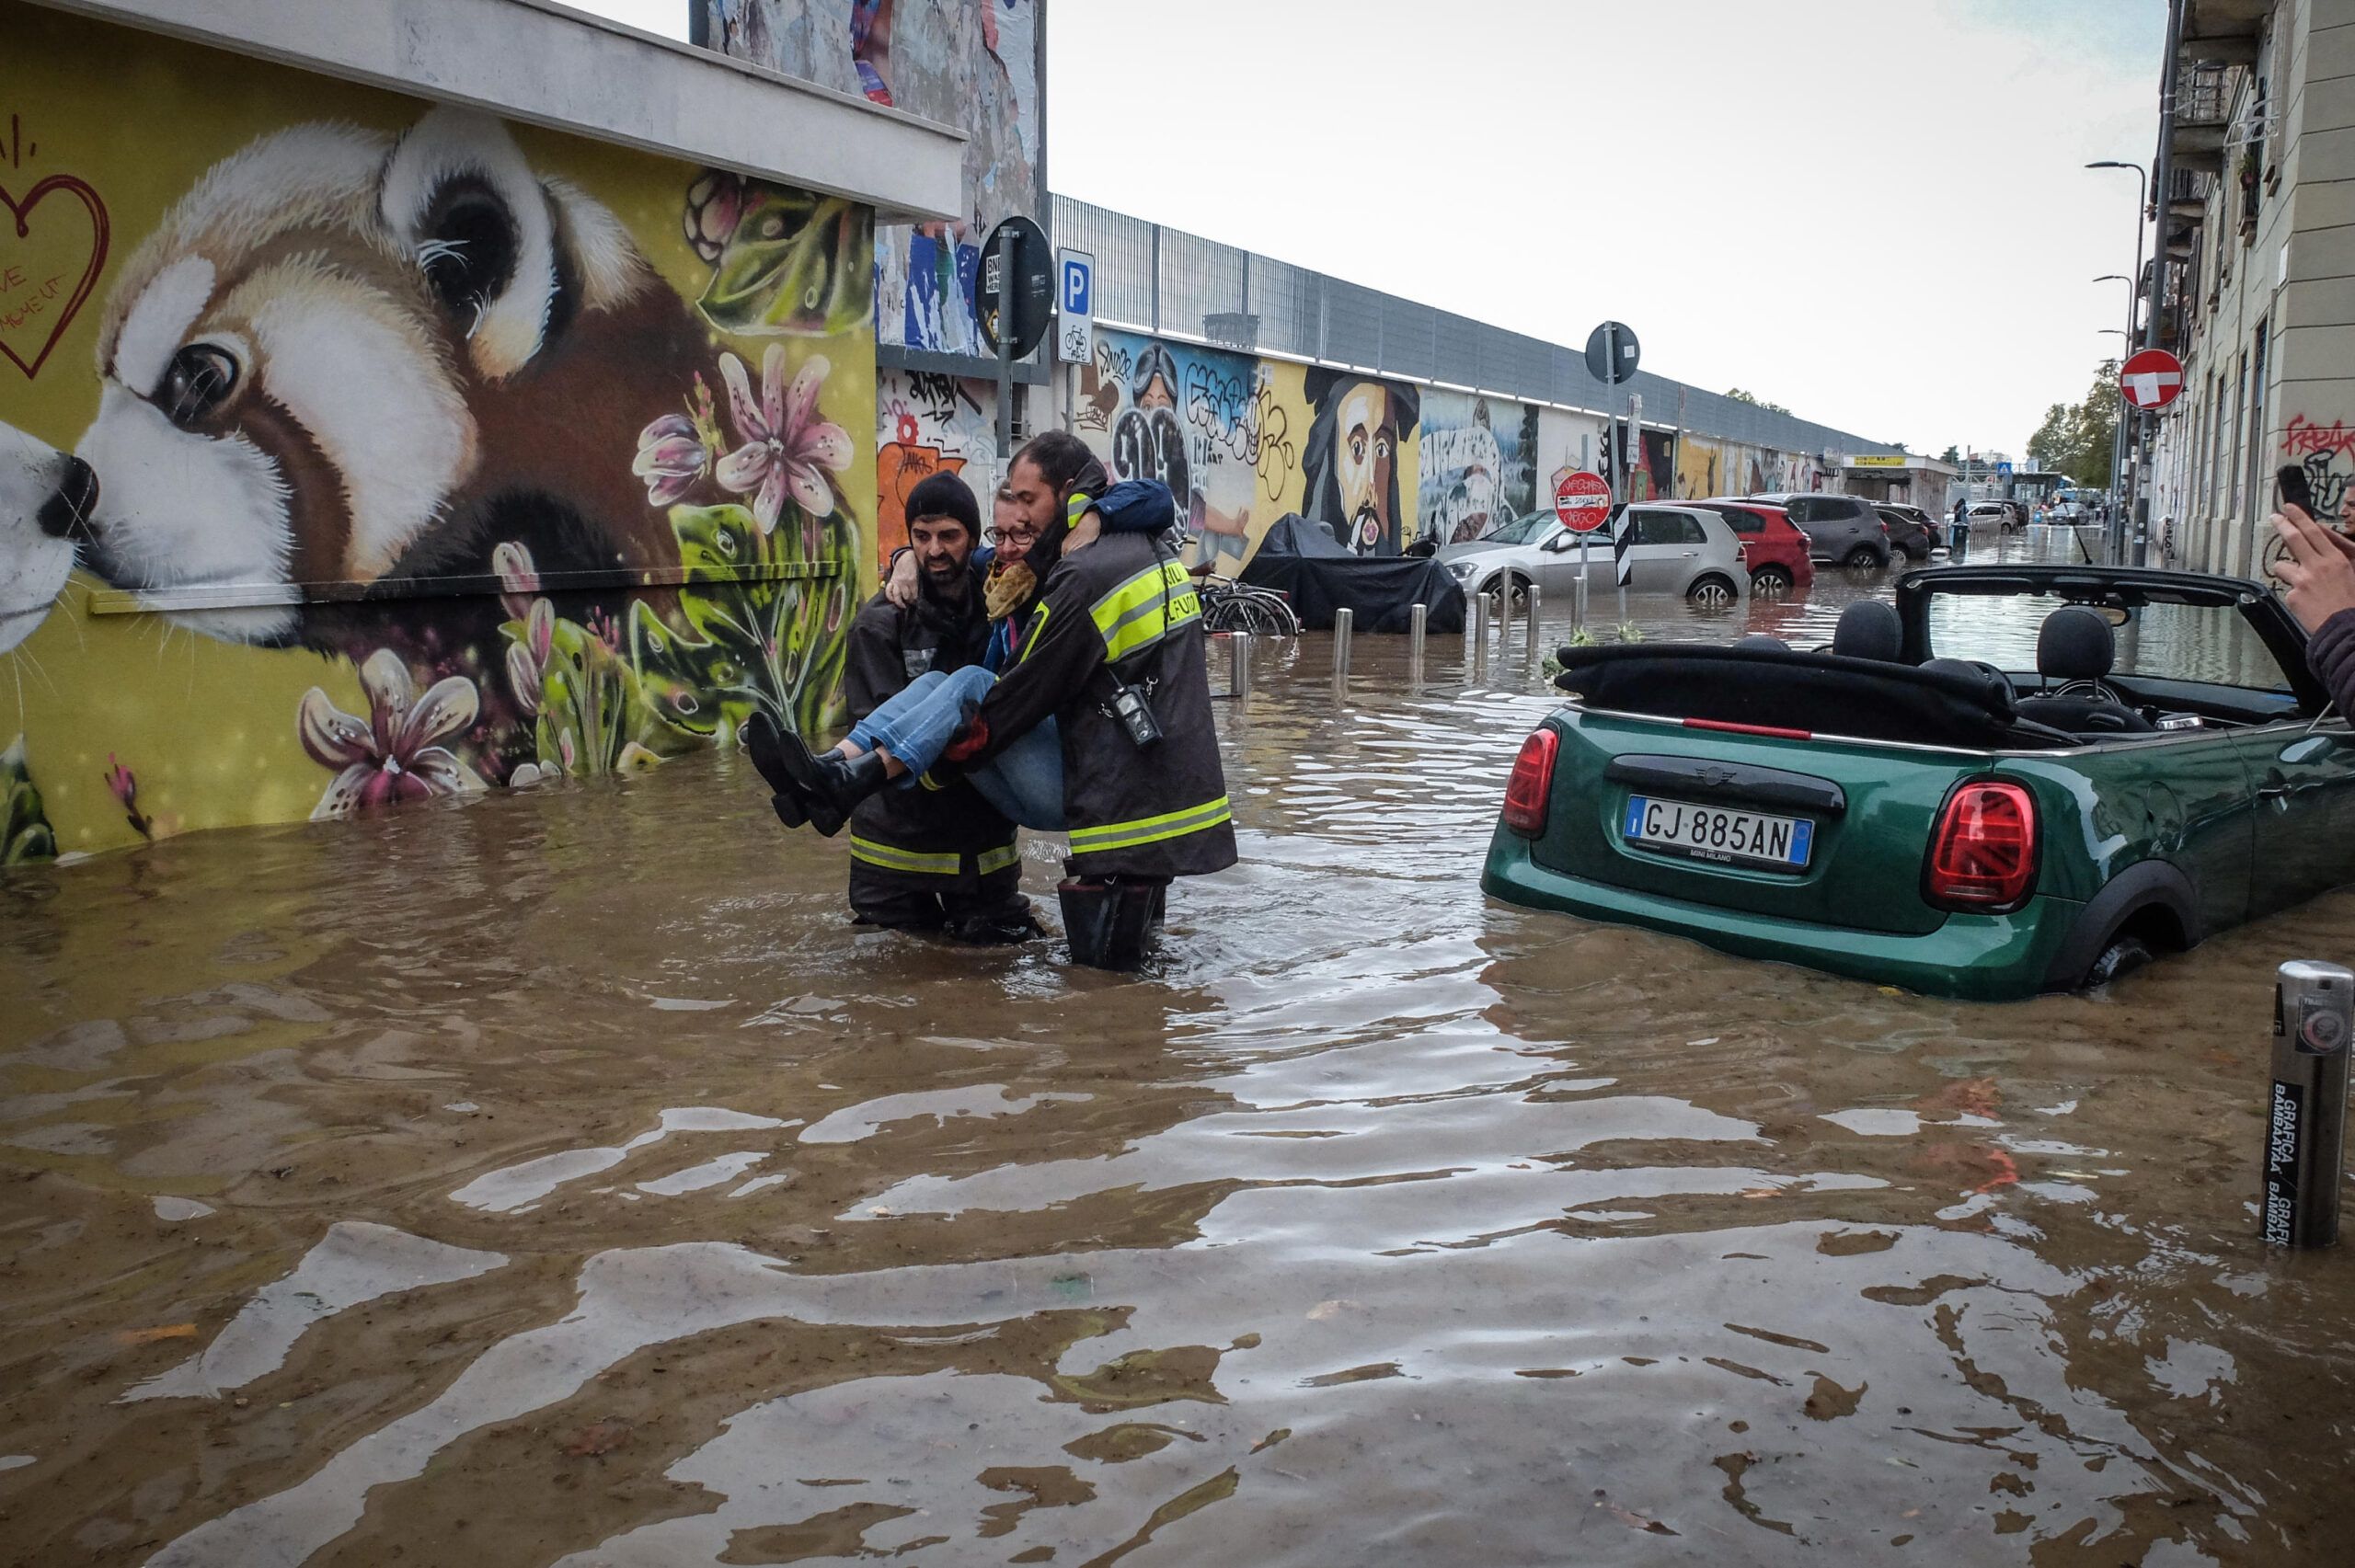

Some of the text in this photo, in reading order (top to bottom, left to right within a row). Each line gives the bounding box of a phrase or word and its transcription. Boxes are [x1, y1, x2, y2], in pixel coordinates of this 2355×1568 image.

[1069, 267, 1085, 308] P
[1646, 804, 1682, 839] GJ
[1691, 810, 1790, 858] 885AN
[1690, 849, 1731, 863] MINI MILANO
[2269, 1083, 2286, 1173] BAMBAATAA
[2280, 1099, 2297, 1163] GRAFICA
